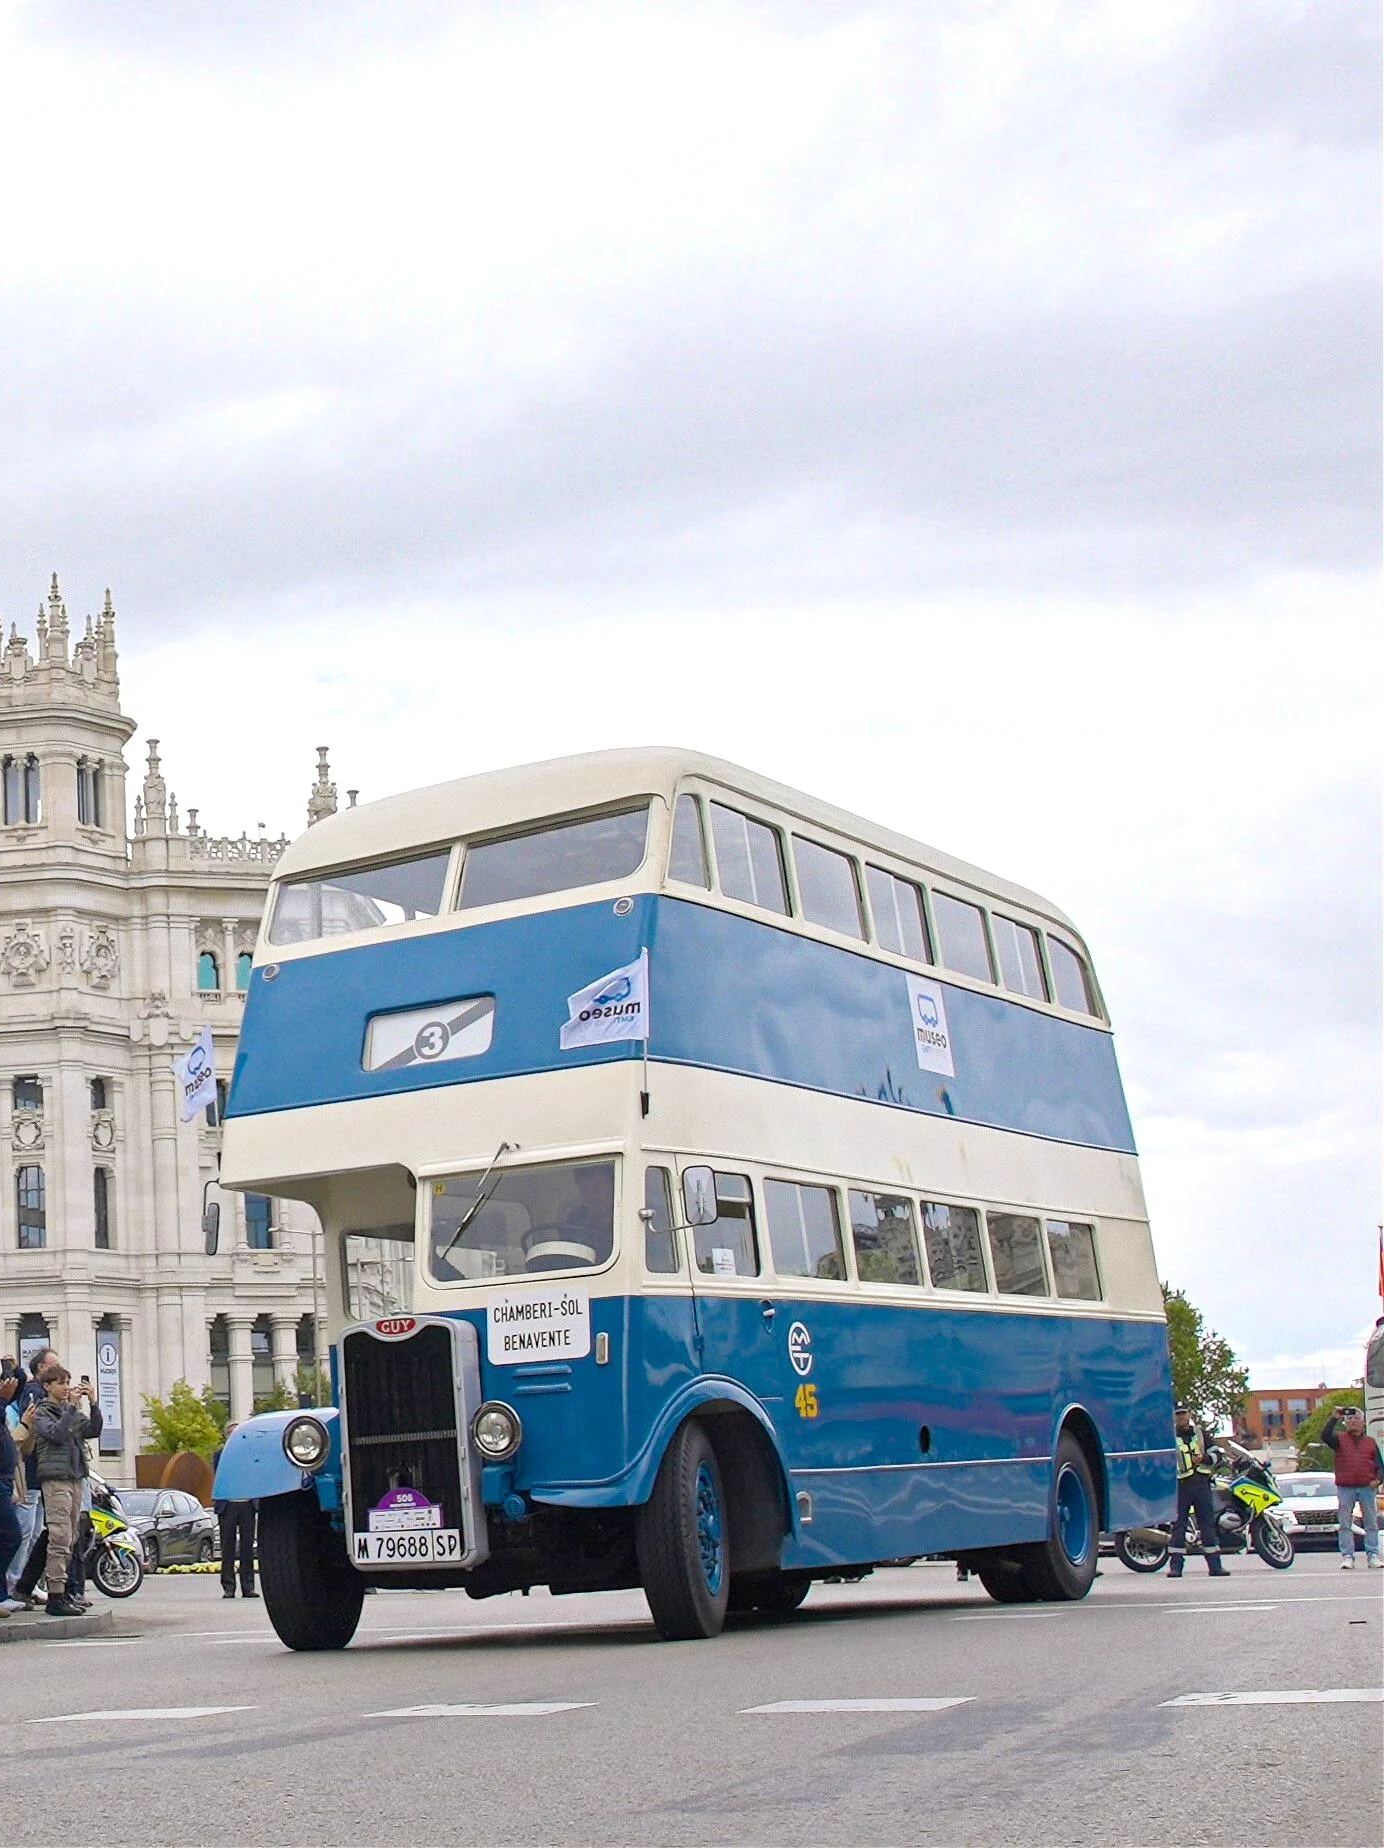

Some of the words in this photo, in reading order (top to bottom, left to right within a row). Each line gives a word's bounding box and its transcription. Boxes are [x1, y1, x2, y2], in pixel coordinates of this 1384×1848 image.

[420, 1026, 444, 1056] 3
[917, 1027, 947, 1048] museo
[493, 1299, 583, 1323] CHAMBERI-SOL
[381, 1319, 411, 1332] GUY
[504, 1329, 571, 1351] BENAVENTE
[795, 1384, 819, 1418] 45
[357, 1538, 370, 1559] M
[376, 1536, 429, 1559] 79688
[436, 1534, 458, 1557] SP
